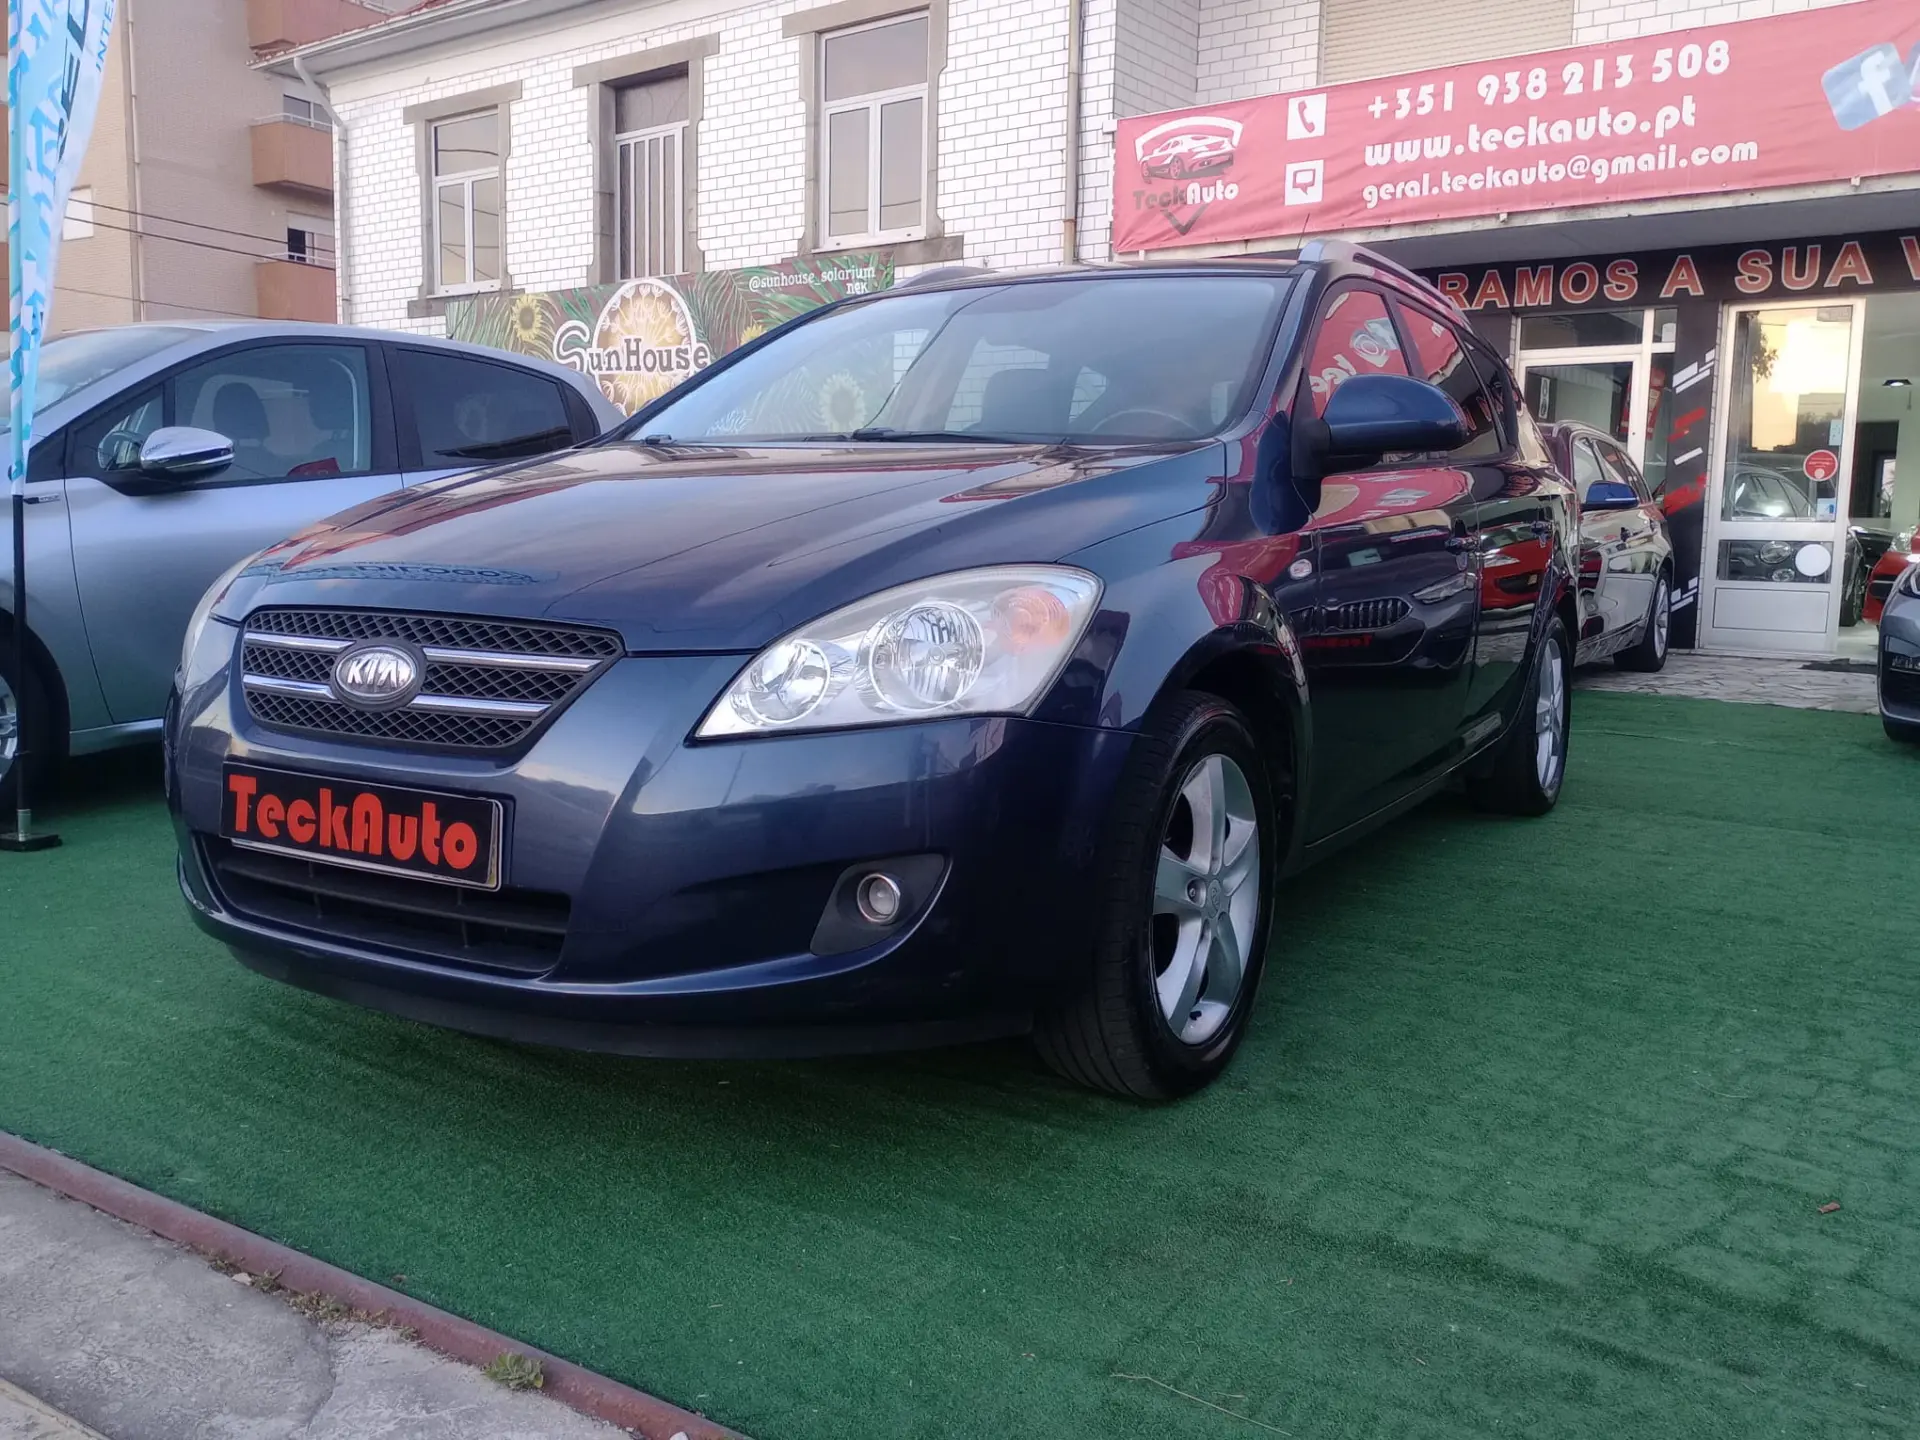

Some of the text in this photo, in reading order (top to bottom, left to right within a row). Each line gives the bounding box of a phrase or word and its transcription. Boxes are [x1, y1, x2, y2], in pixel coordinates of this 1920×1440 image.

[1368, 39, 1730, 120] +351 938 213 508
[1364, 95, 1696, 167] www.teckauto.pt
[1133, 179, 1239, 210] TeckAuto
[1362, 140, 1758, 209] geral.teckauto@gmail.com
[748, 264, 876, 292] @sunhouse_solarium
[1421, 259, 1639, 311] RAMOS
[1660, 254, 1705, 297] A
[1735, 241, 1873, 294] SUA
[554, 323, 710, 373] SunHouse
[347, 658, 400, 687] KIA
[228, 774, 478, 870] TeckAuto
